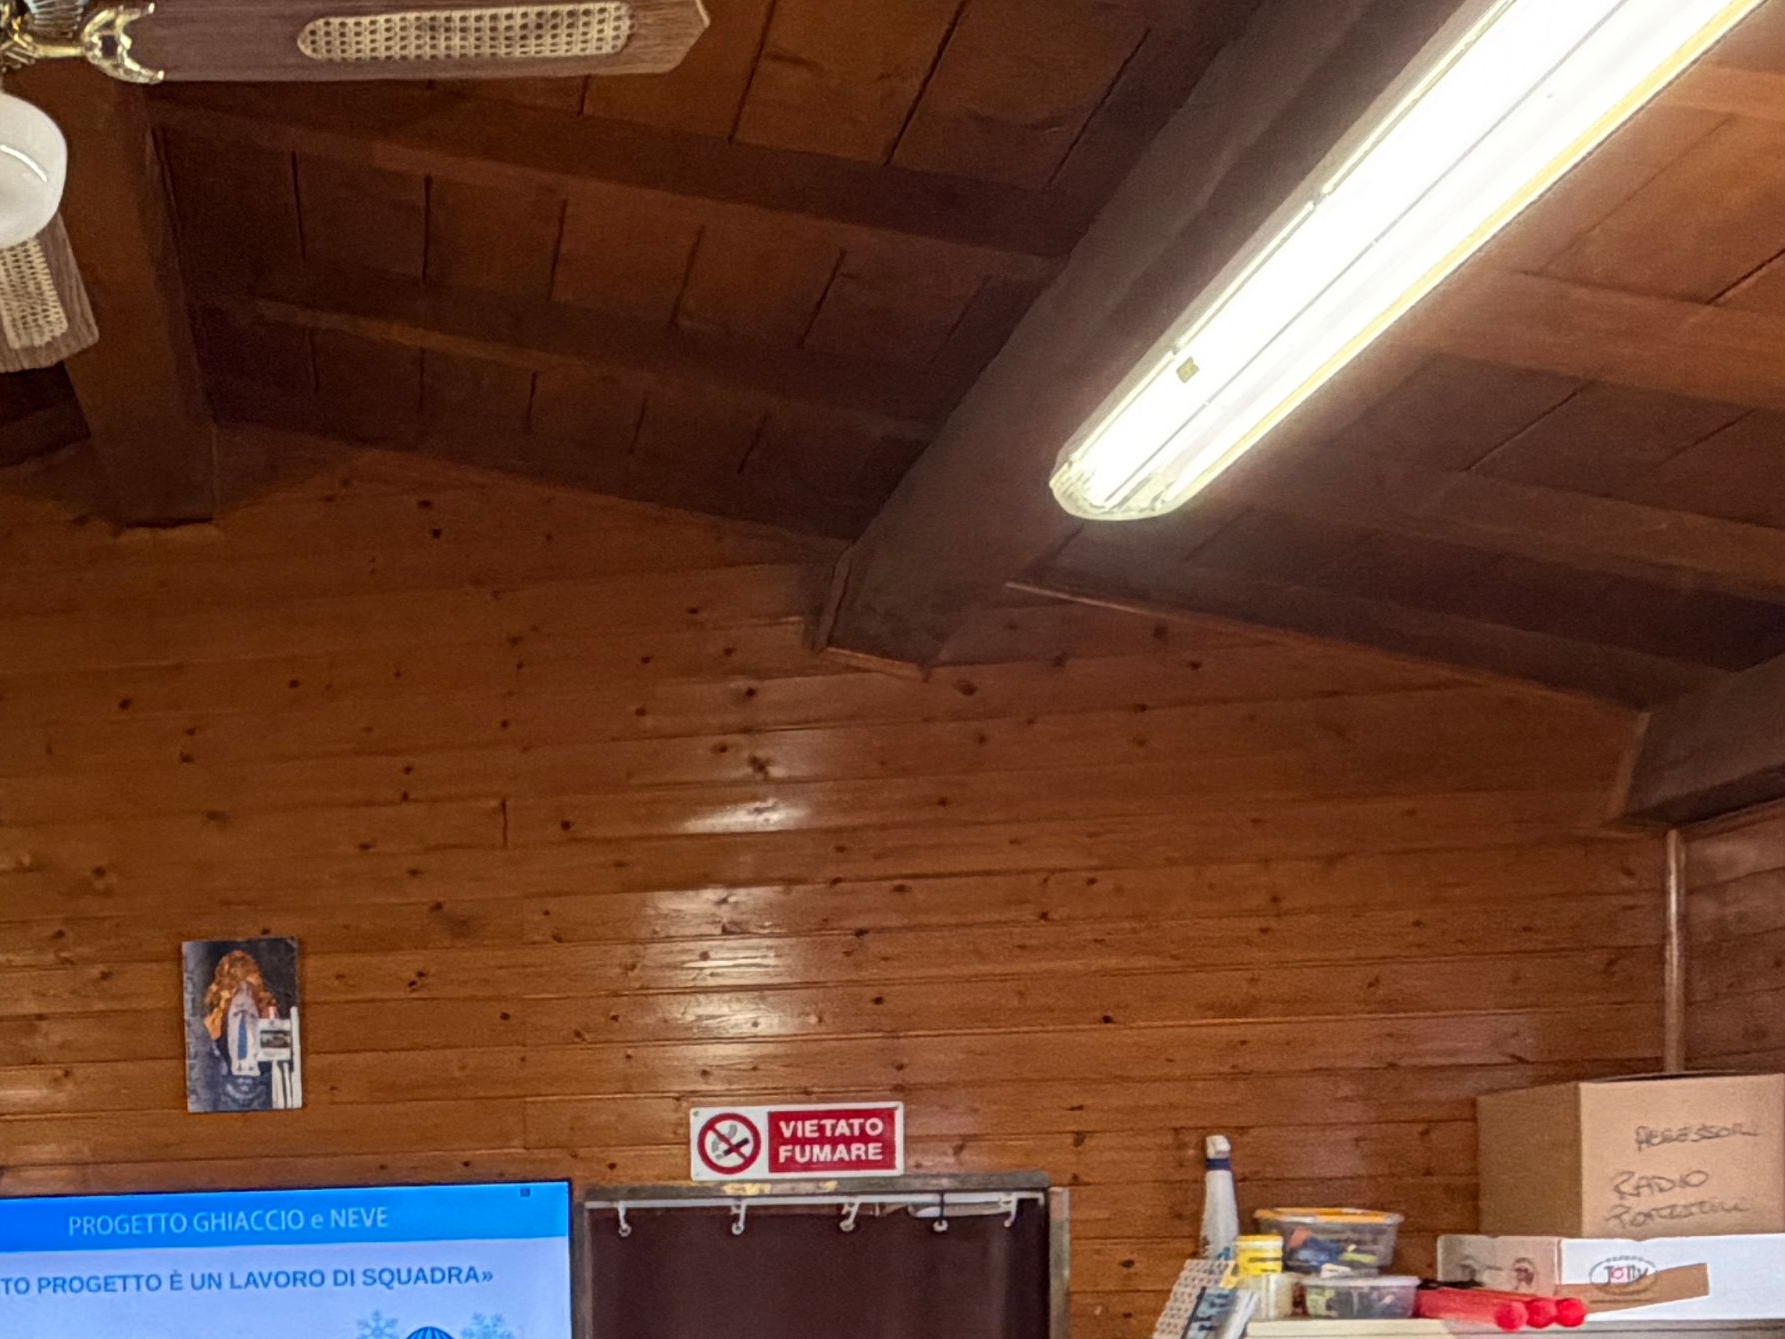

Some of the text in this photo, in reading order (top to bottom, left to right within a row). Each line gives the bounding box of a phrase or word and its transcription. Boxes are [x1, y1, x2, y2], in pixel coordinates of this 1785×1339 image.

[779, 1118, 884, 1139] VIETATO
[779, 1143, 883, 1163] FUMARE
[68, 1207, 390, 1237] PROGETTO GHIACCIO e NEVE
[37, 1273, 162, 1294] PROGETTO
[170, 1269, 183, 1291] È
[191, 1272, 223, 1291] UN
[229, 1269, 325, 1290] LAVORO
[333, 1268, 355, 1287] DI
[362, 1265, 493, 1290] SQUADRA»
